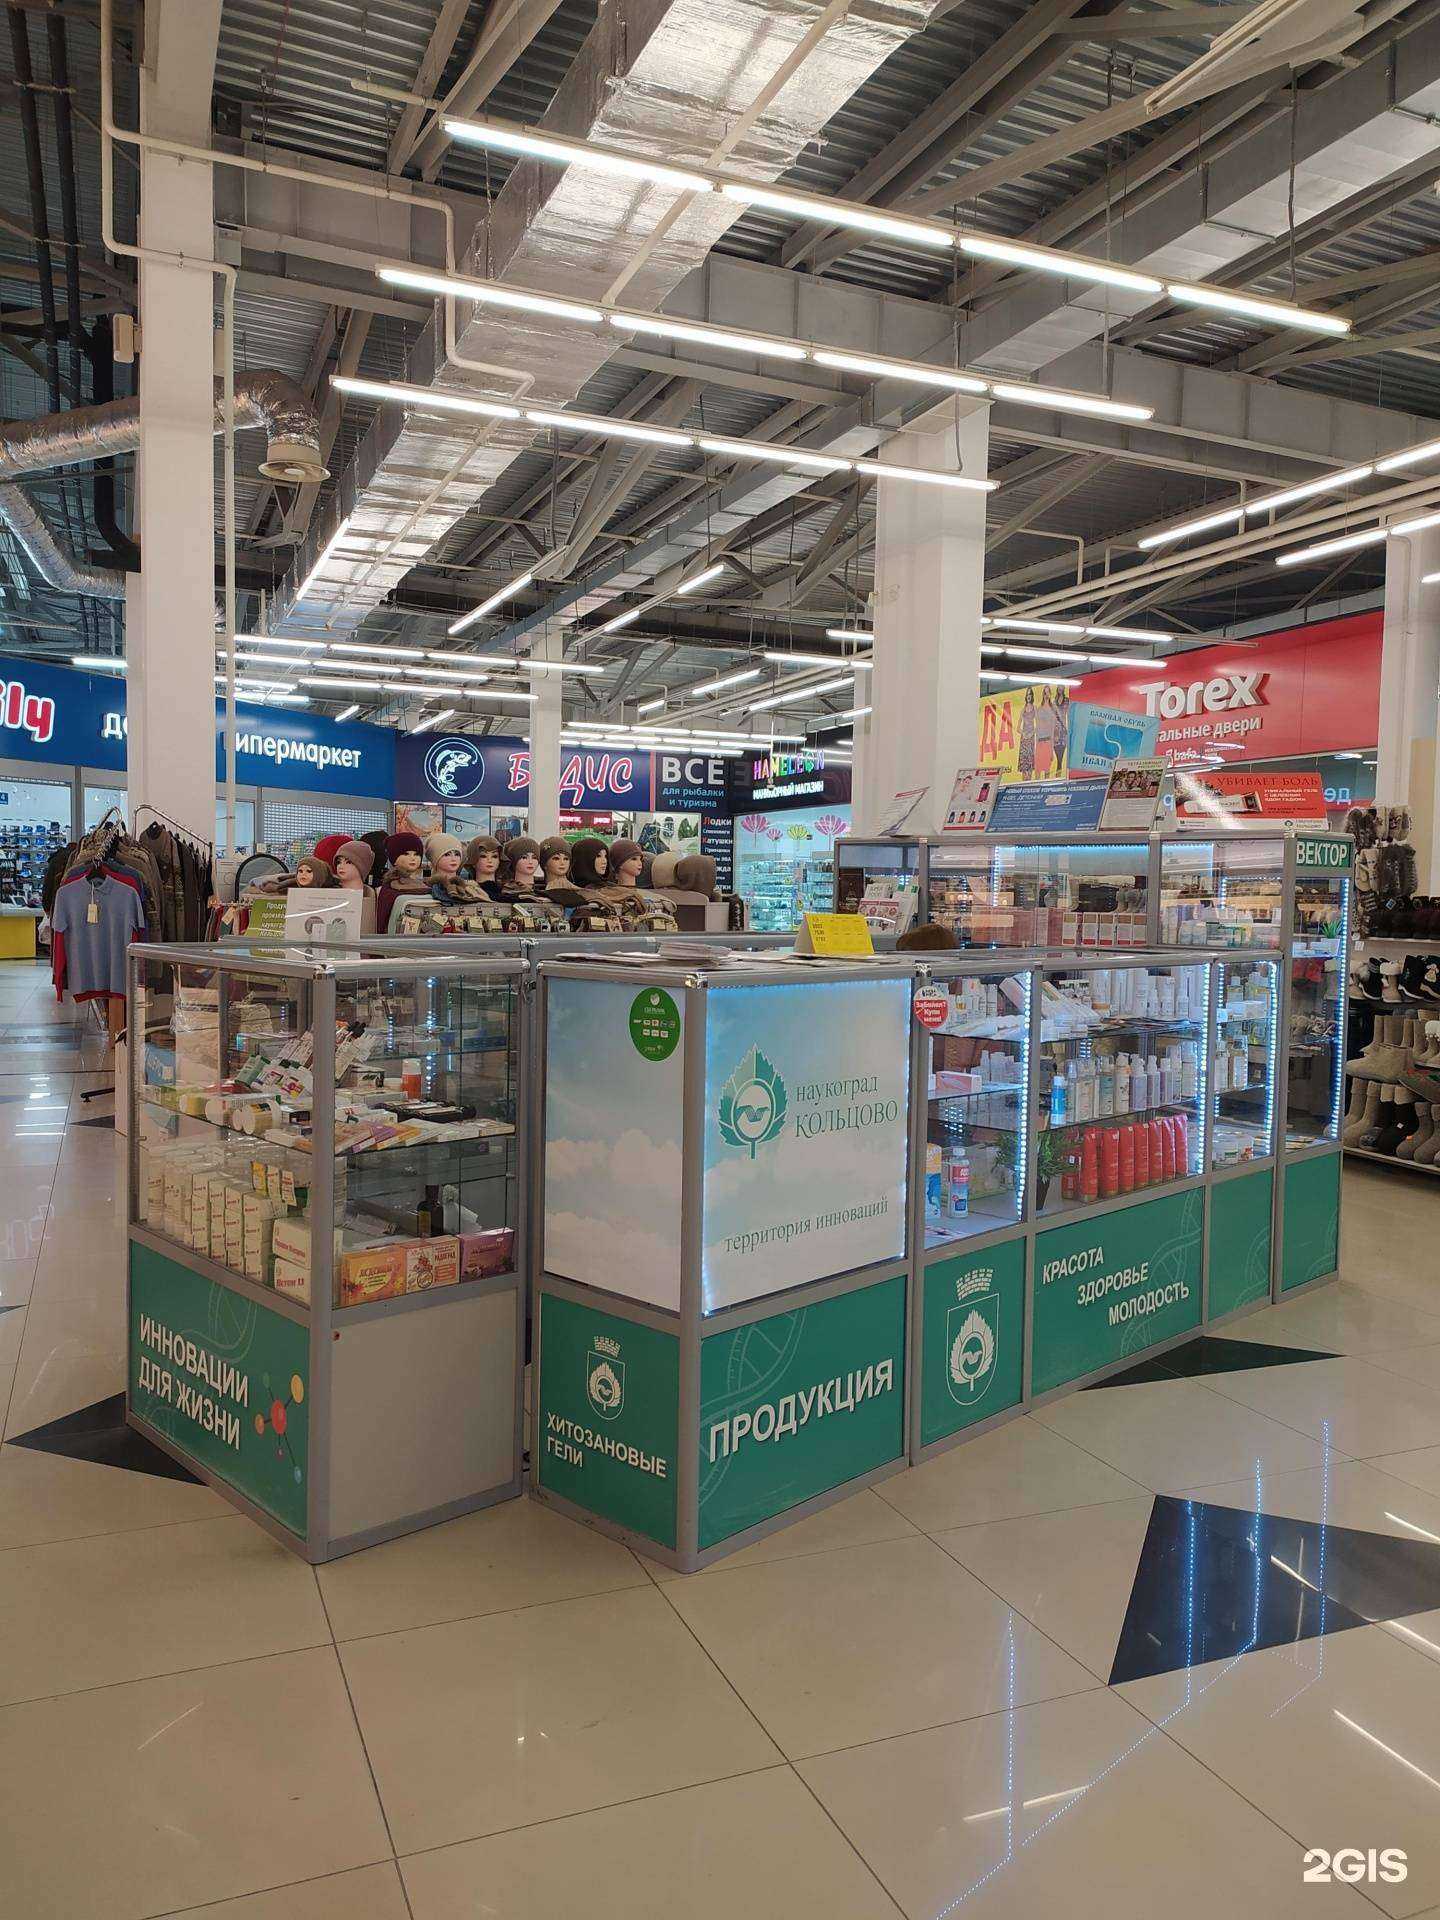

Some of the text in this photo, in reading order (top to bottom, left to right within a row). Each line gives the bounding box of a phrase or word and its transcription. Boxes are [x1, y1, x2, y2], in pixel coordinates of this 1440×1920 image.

[1139, 671, 1260, 719] Torex
[1156, 717, 1261, 743] альные двери
[235, 732, 362, 770] ипермаркет
[662, 753, 725, 786] ВСЁ
[507, 751, 633, 806] БДИС
[662, 787, 725, 798] для рыбалки
[1217, 775, 1319, 786] УБИВАЕТ БОЛЬ
[668, 798, 718, 809] и туризма
[702, 816, 732, 826] Лодки
[702, 836, 733, 845] Катушки
[1296, 841, 1348, 867] ВЕКТОР
[796, 1074, 879, 1106] наукоград
[795, 1100, 898, 1139] КОЛЬЦОВО
[724, 1195, 889, 1254] территория инноваций
[1042, 1246, 1104, 1285] КРАСОТА
[1077, 1261, 1149, 1306] ЗДОРОВЬЕ
[1108, 1280, 1190, 1326] МОЛОДОСТЬ
[140, 1312, 249, 1408] ИННОВАЦИИ
[139, 1356, 241, 1450] ДЛЯ ЖИЗНИ
[709, 1358, 894, 1464] ПРОДУКЦИЯ
[547, 1411, 667, 1479] ХИТОЗАНОВЫЕ
[547, 1436, 584, 1468] ГЕЛИ
